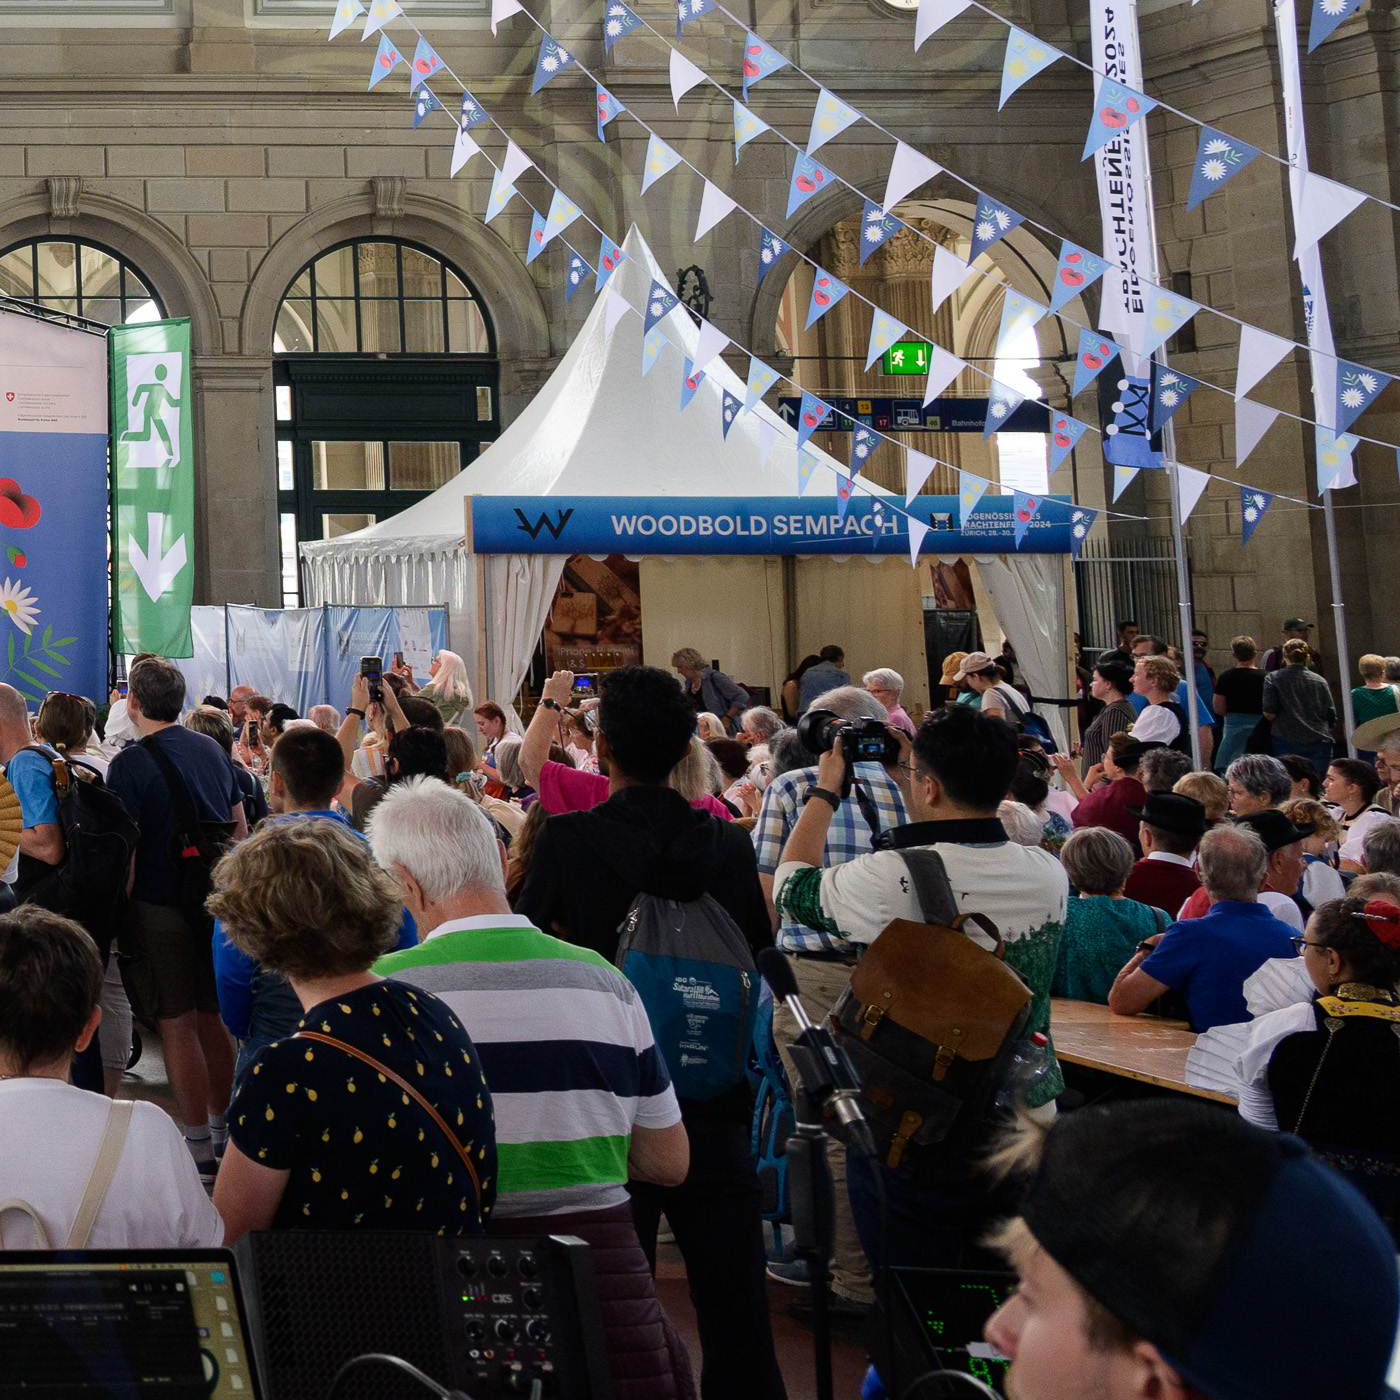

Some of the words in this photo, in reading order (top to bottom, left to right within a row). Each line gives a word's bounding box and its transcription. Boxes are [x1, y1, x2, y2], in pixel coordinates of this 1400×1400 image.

[860, 403, 869, 411] 13
[611, 515, 767, 535] WOODBOLD
[1029, 520, 1051, 528] 2024
